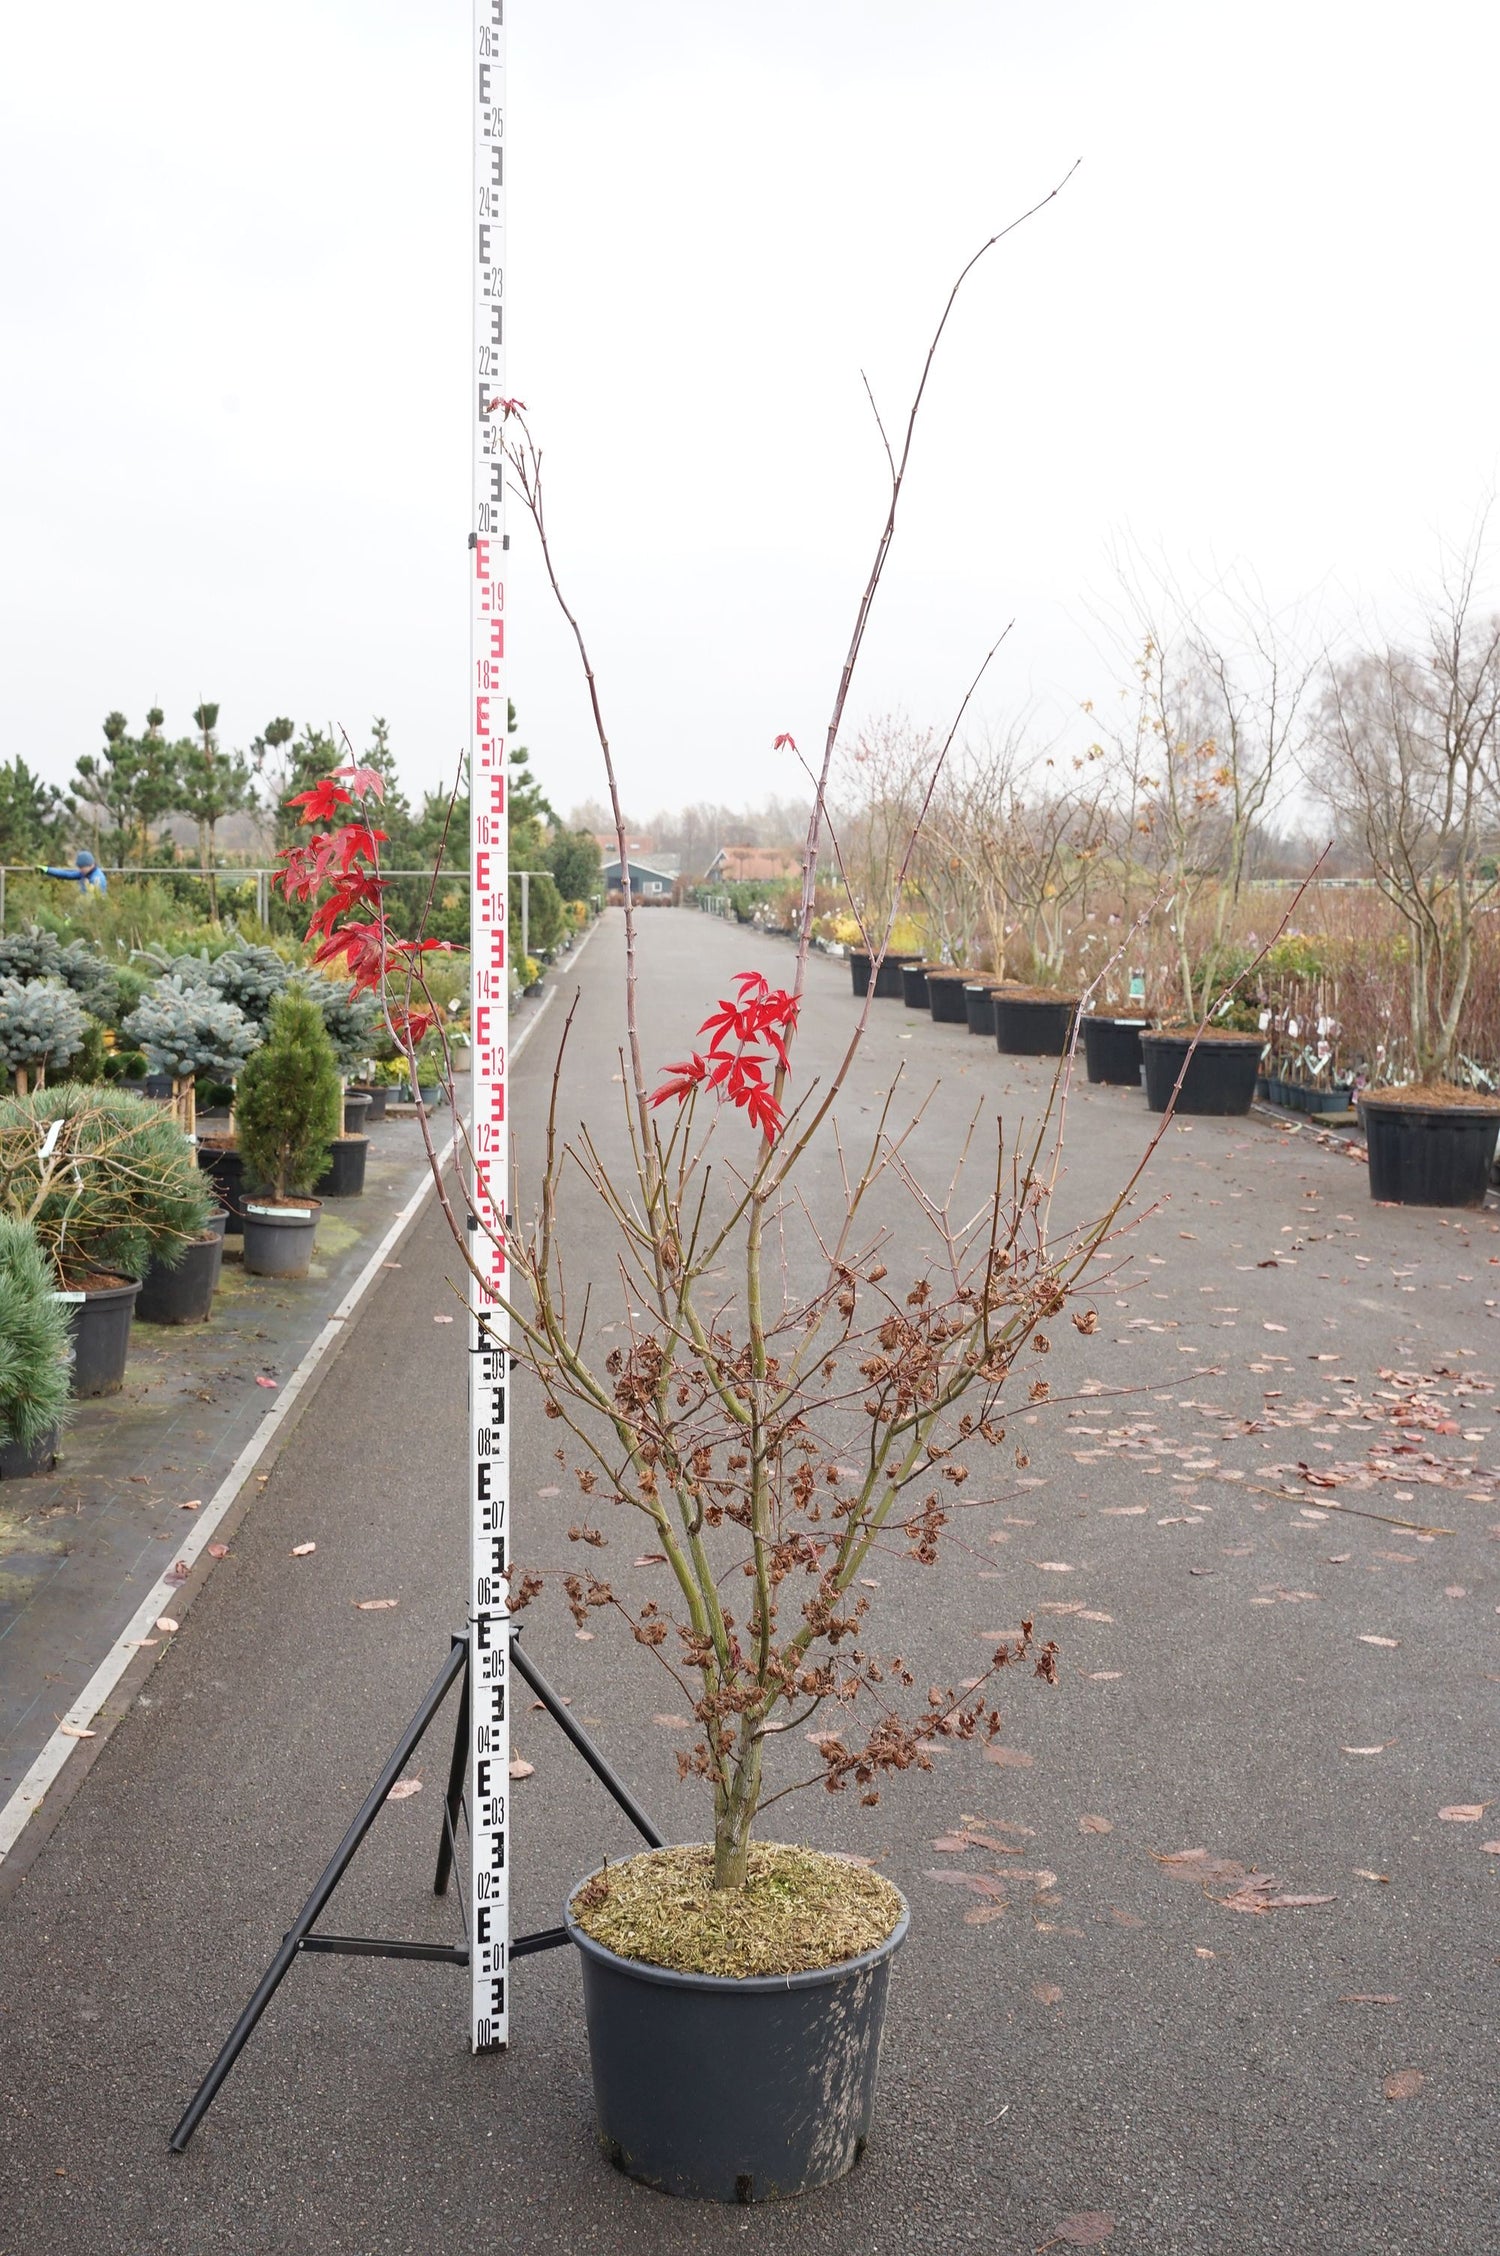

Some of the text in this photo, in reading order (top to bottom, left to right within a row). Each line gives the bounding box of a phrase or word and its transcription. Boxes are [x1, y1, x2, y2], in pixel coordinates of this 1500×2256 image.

[480, 26, 490, 56] 26
[492, 107, 503, 137] 25
[479, 187, 490, 217] 24
[492, 267, 502, 297] 23
[479, 346, 490, 375] 22
[491, 425, 502, 455] 21
[479, 503, 489, 532] 20
[491, 581, 503, 611] 19
[477, 659, 489, 689] 18
[491, 738, 504, 766] 17
[477, 816, 489, 844] 16
[491, 893, 504, 921] 15
[477, 970, 489, 999] 14
[491, 1047, 504, 1075] 13
[477, 1124, 490, 1152] 12
[492, 1351, 505, 1379] 09
[478, 1428, 490, 1456] 08
[492, 1501, 504, 1529] 07
[478, 1577, 490, 1605] 06
[492, 1650, 504, 1678] 05
[478, 1725, 490, 1753] 04
[492, 1797, 504, 1825] 03
[478, 1872, 490, 1900] 02
[493, 1942, 504, 1971] 01
[478, 2018, 490, 2046] 00
